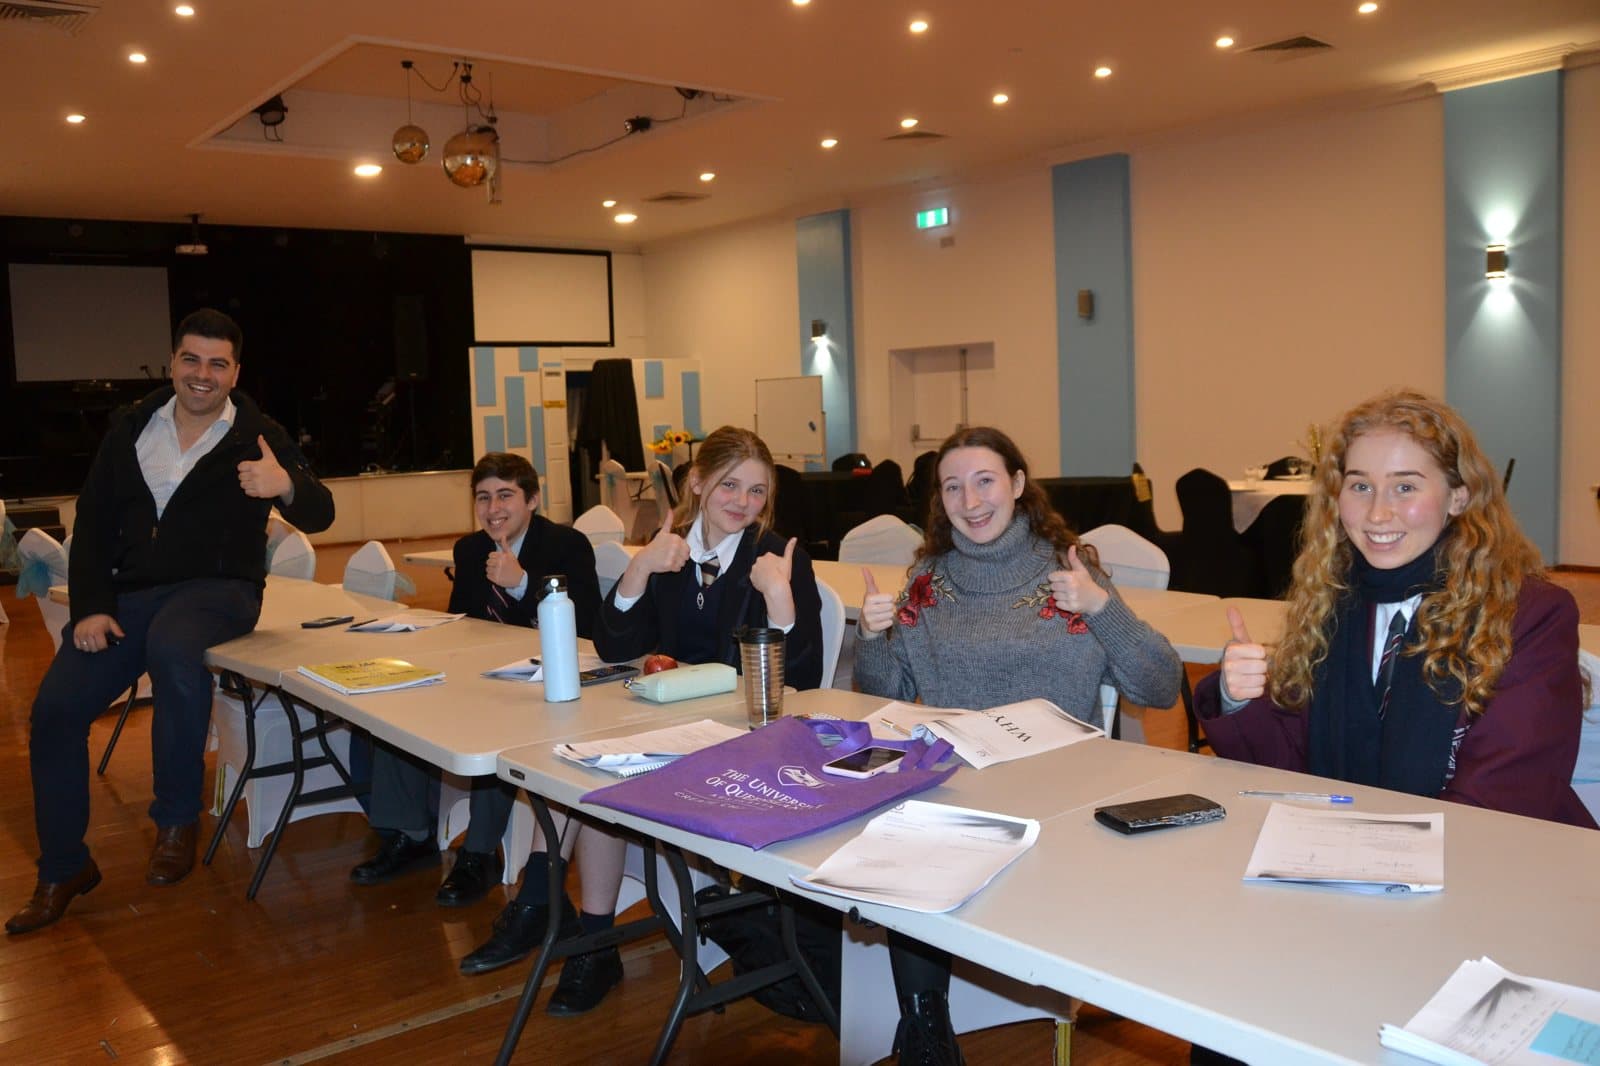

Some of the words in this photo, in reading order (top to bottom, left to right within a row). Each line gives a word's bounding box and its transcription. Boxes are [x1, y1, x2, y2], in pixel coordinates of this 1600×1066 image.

[705, 776, 728, 788] OF
[721, 769, 750, 783] THE
[748, 778, 824, 810] UNIVERS
